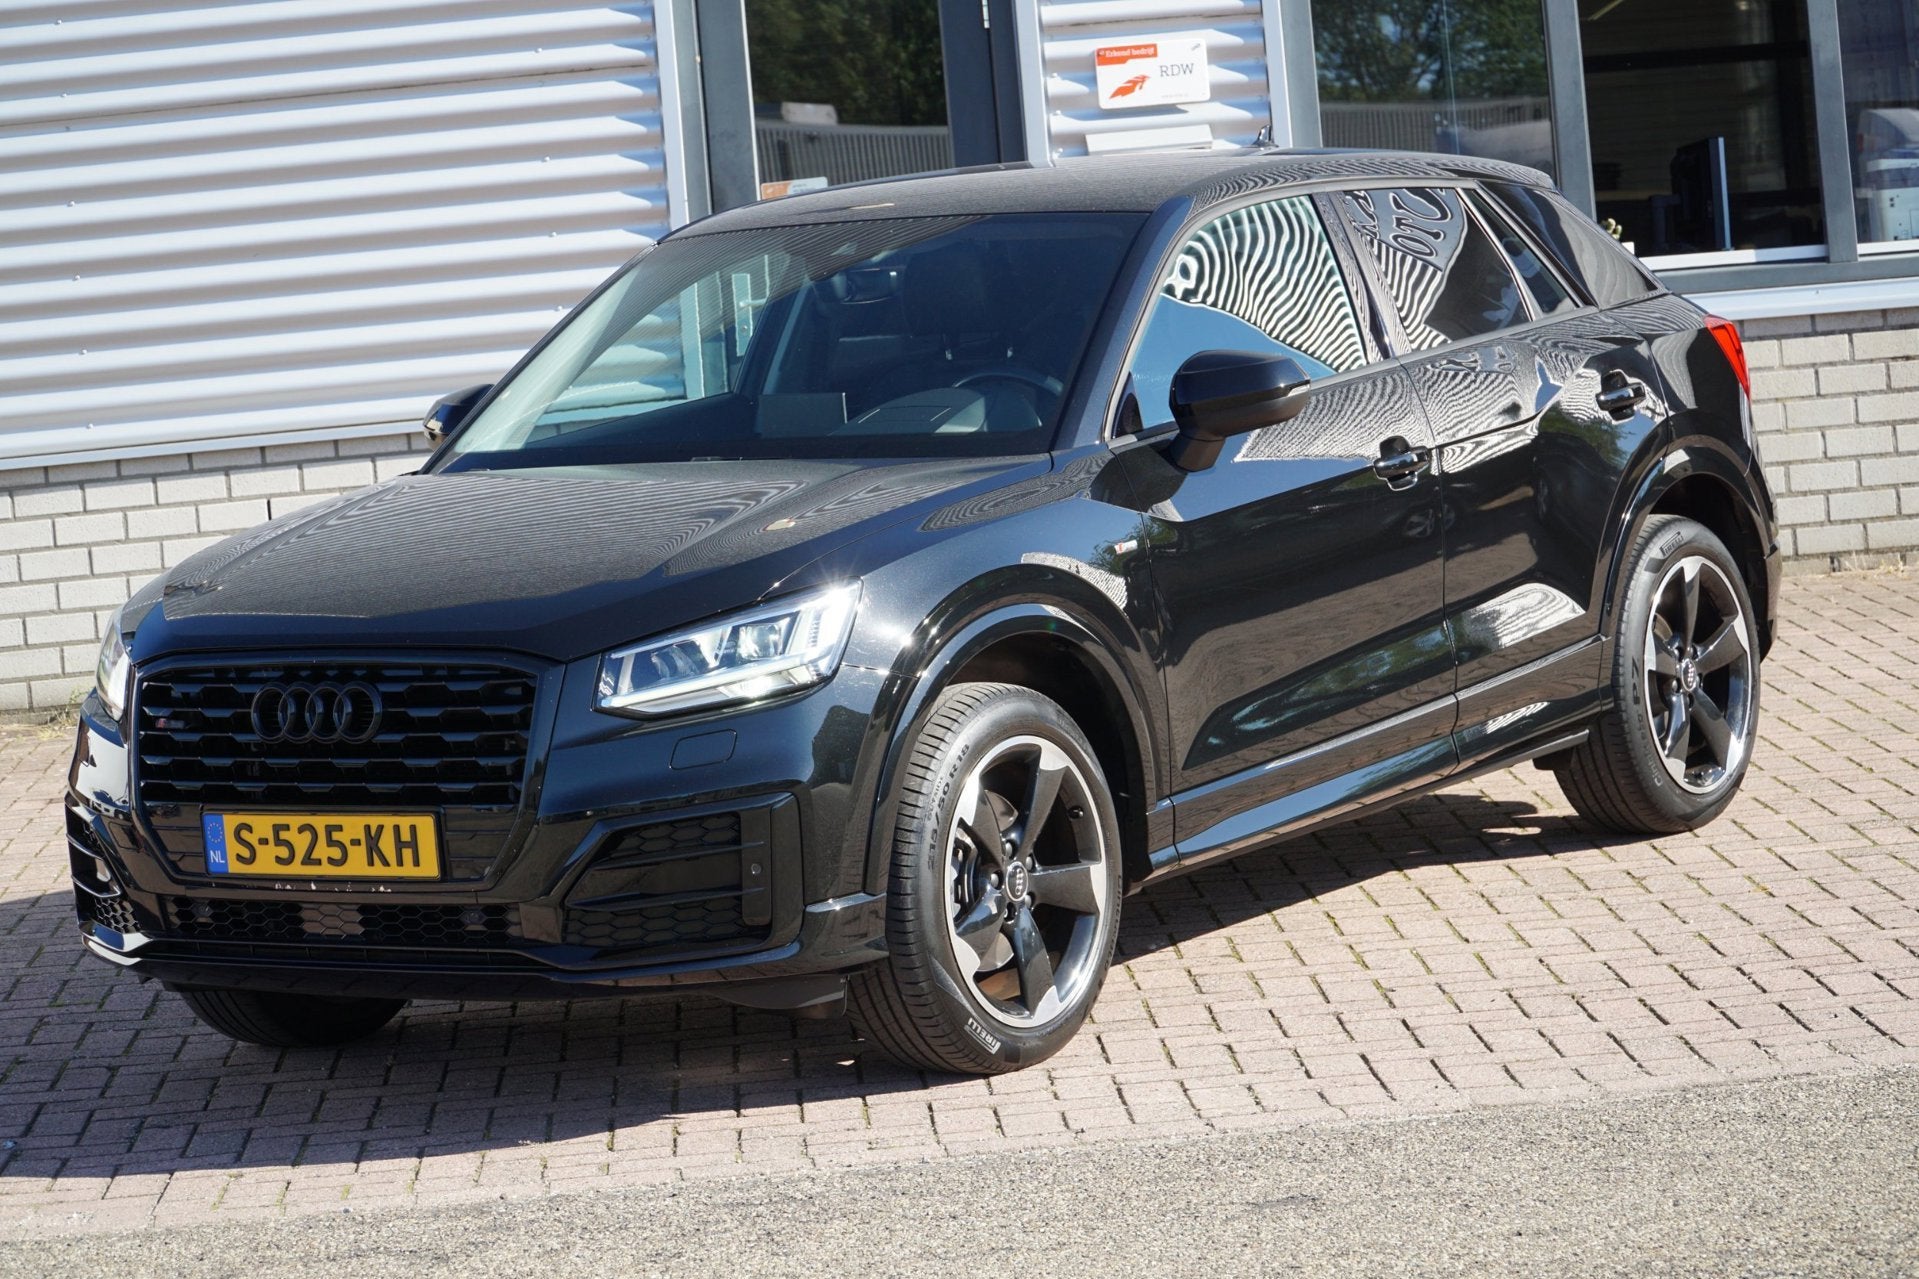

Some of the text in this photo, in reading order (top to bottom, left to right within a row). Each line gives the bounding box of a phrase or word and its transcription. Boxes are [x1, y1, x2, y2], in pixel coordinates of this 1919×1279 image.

[1159, 62, 1195, 77] RDW
[210, 850, 226, 864] NL
[233, 822, 421, 867] S-525-KH
[964, 1017, 1002, 1055] PIRELLI
